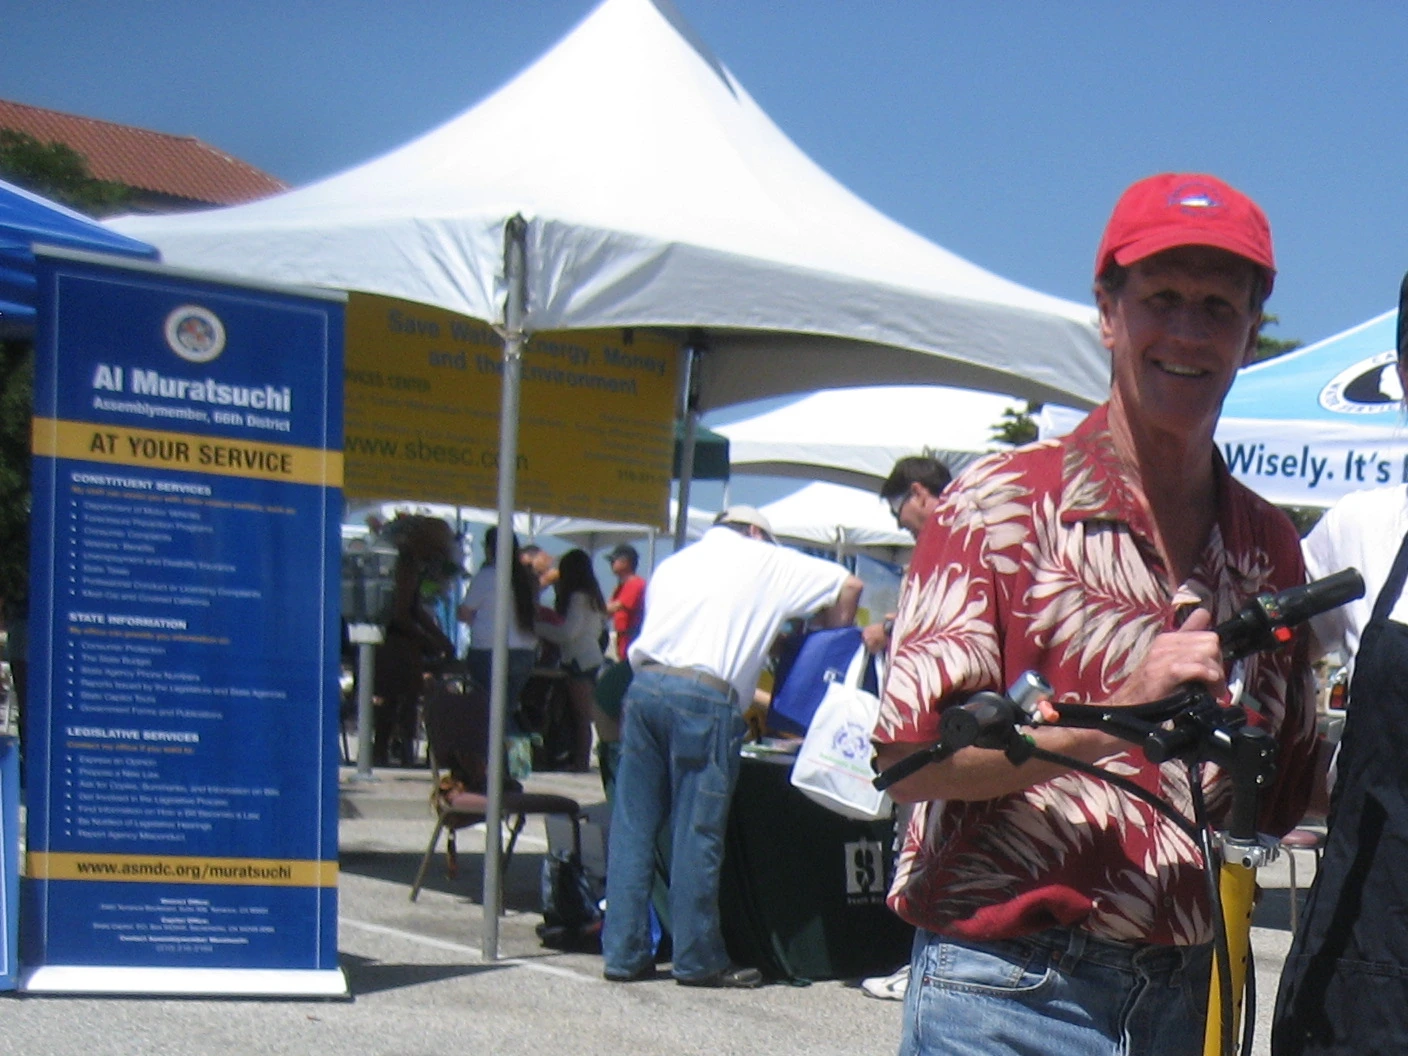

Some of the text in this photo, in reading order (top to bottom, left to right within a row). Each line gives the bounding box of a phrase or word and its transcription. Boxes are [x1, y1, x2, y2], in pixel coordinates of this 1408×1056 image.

[92, 364, 292, 412] Al Muratsuchi
[246, 413, 291, 432] District
[90, 432, 292, 474] AT YOUR SERVICE
[1224, 442, 1334, 488] Wisely.
[1344, 449, 1391, 484] It's
[71, 473, 212, 496] CONSTITUENT SERVICES
[68, 611, 188, 630] STATE INFORMATION
[66, 726, 200, 743] LEGISLATIVE SERVICES
[77, 860, 292, 880] www.asmdc.org/muratsuchi
